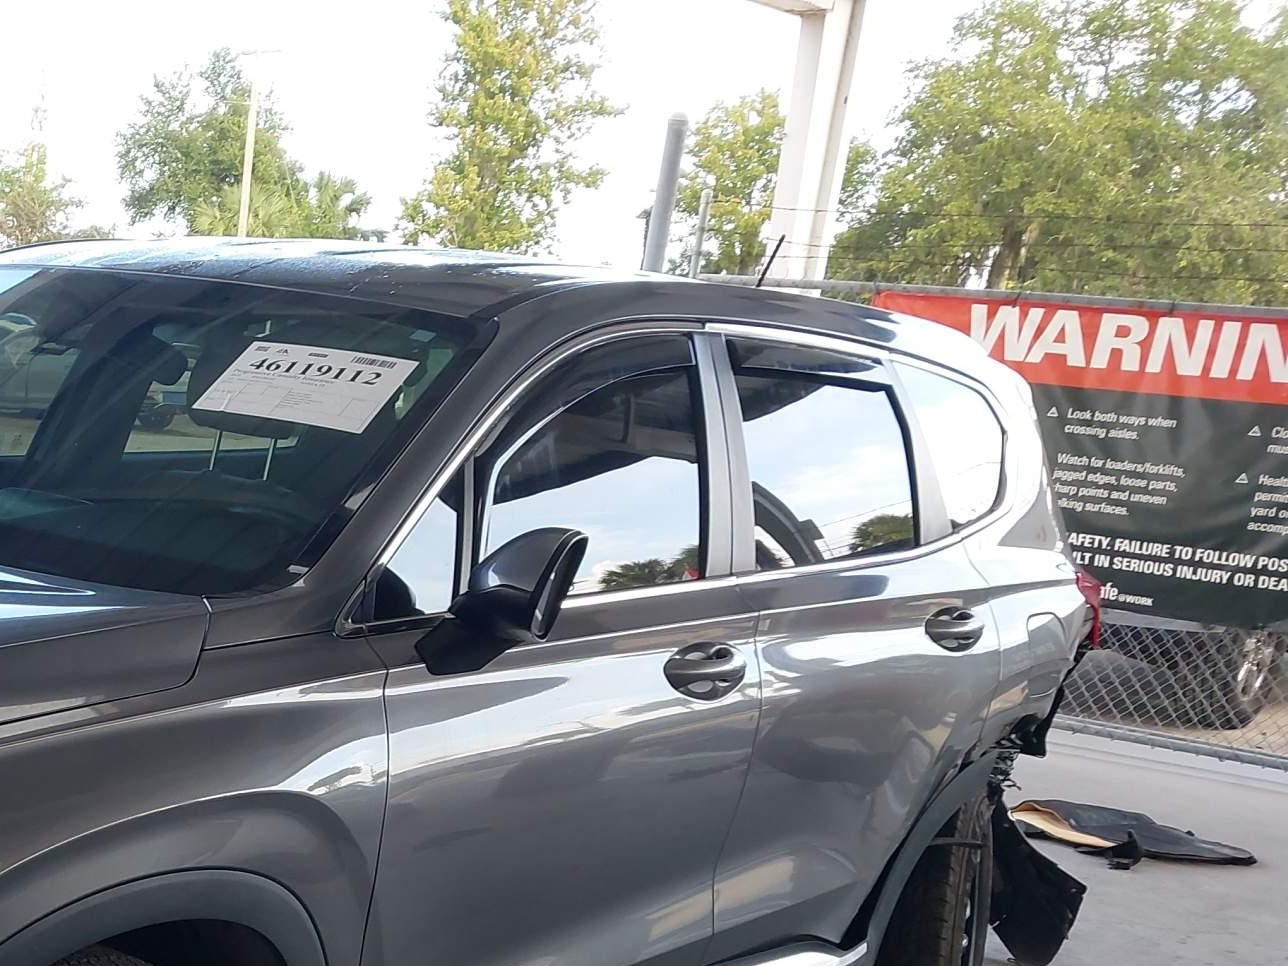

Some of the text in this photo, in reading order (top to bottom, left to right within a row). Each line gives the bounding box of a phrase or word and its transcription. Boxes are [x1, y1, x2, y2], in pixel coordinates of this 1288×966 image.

[970, 303, 1288, 383] WARNIN
[249, 357, 383, 386] 46119112
[1067, 407, 1177, 428] Look both ways when
[1064, 424, 1139, 440] crossing aisles.
[1057, 453, 1185, 478] Watch for loaders/forklifts,
[1052, 467, 1178, 492] jagged edges, loose parts,
[1053, 482, 1167, 505] harp points and uneven
[1084, 502, 1129, 516] surfaces.
[1250, 506, 1277, 518] yard
[1066, 532, 1288, 573] AFETY. FAILURE TO FOLLOW POS
[1093, 554, 1111, 568] IN
[1112, 556, 1174, 577] SERIOUS
[1176, 565, 1232, 584] INJURY
[1233, 572, 1255, 587] OR
[1257, 575, 1288, 592] DEA
